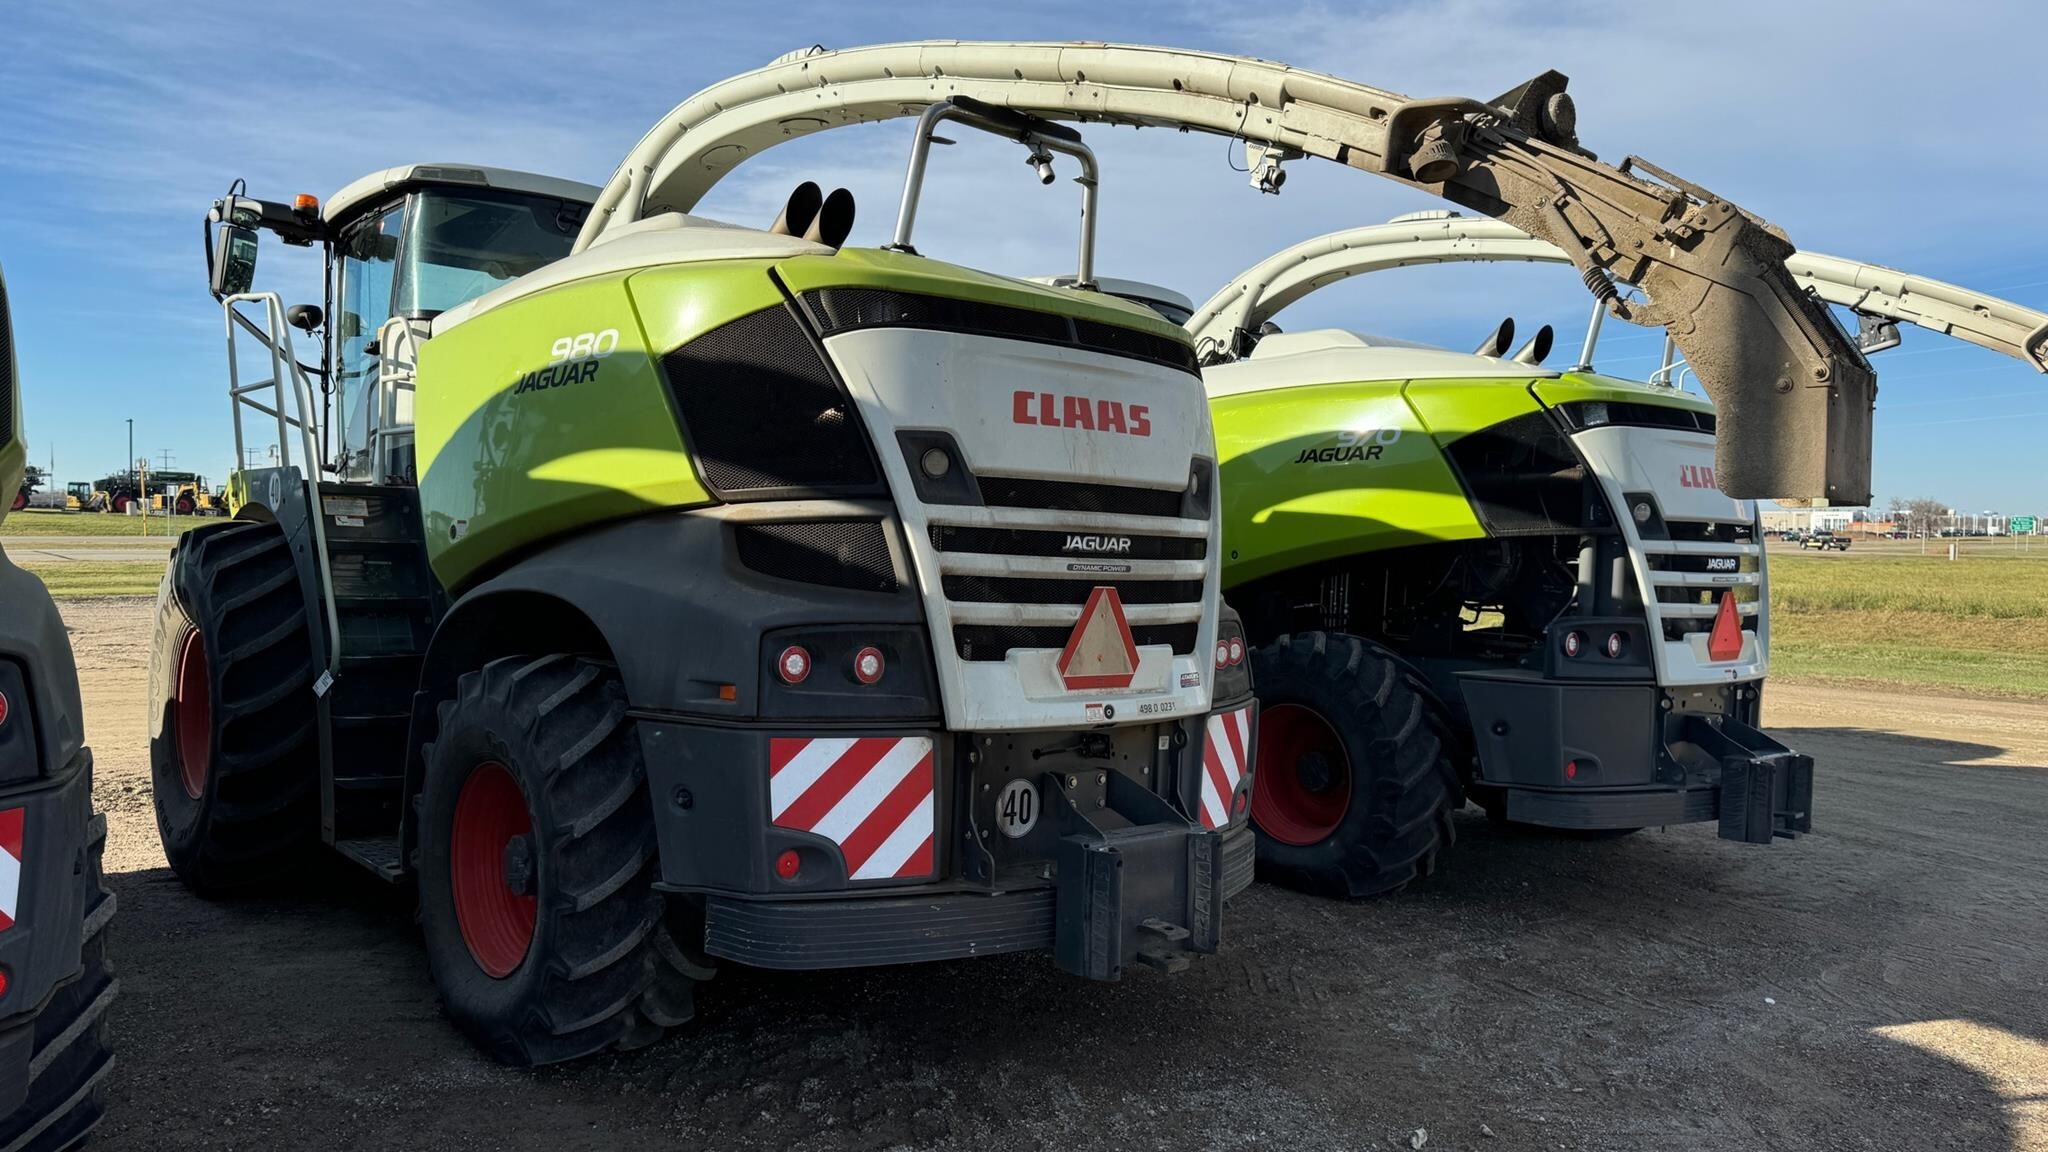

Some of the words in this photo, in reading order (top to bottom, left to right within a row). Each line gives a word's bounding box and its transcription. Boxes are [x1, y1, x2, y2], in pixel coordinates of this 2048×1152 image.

[549, 328, 620, 367] 980
[514, 360, 599, 395] JAGUAR
[1013, 390, 1151, 437] CLAAS
[1294, 445, 1384, 464] JAGUAR
[1680, 464, 1717, 489] CLA
[1062, 535, 1132, 553] JAGUAR
[1072, 564, 1103, 572] DYNAMIC
[1102, 564, 1128, 573] POWER
[1706, 558, 1737, 570] JAGUAR
[1139, 703, 1153, 714] 498
[1003, 788, 1032, 826] 40
